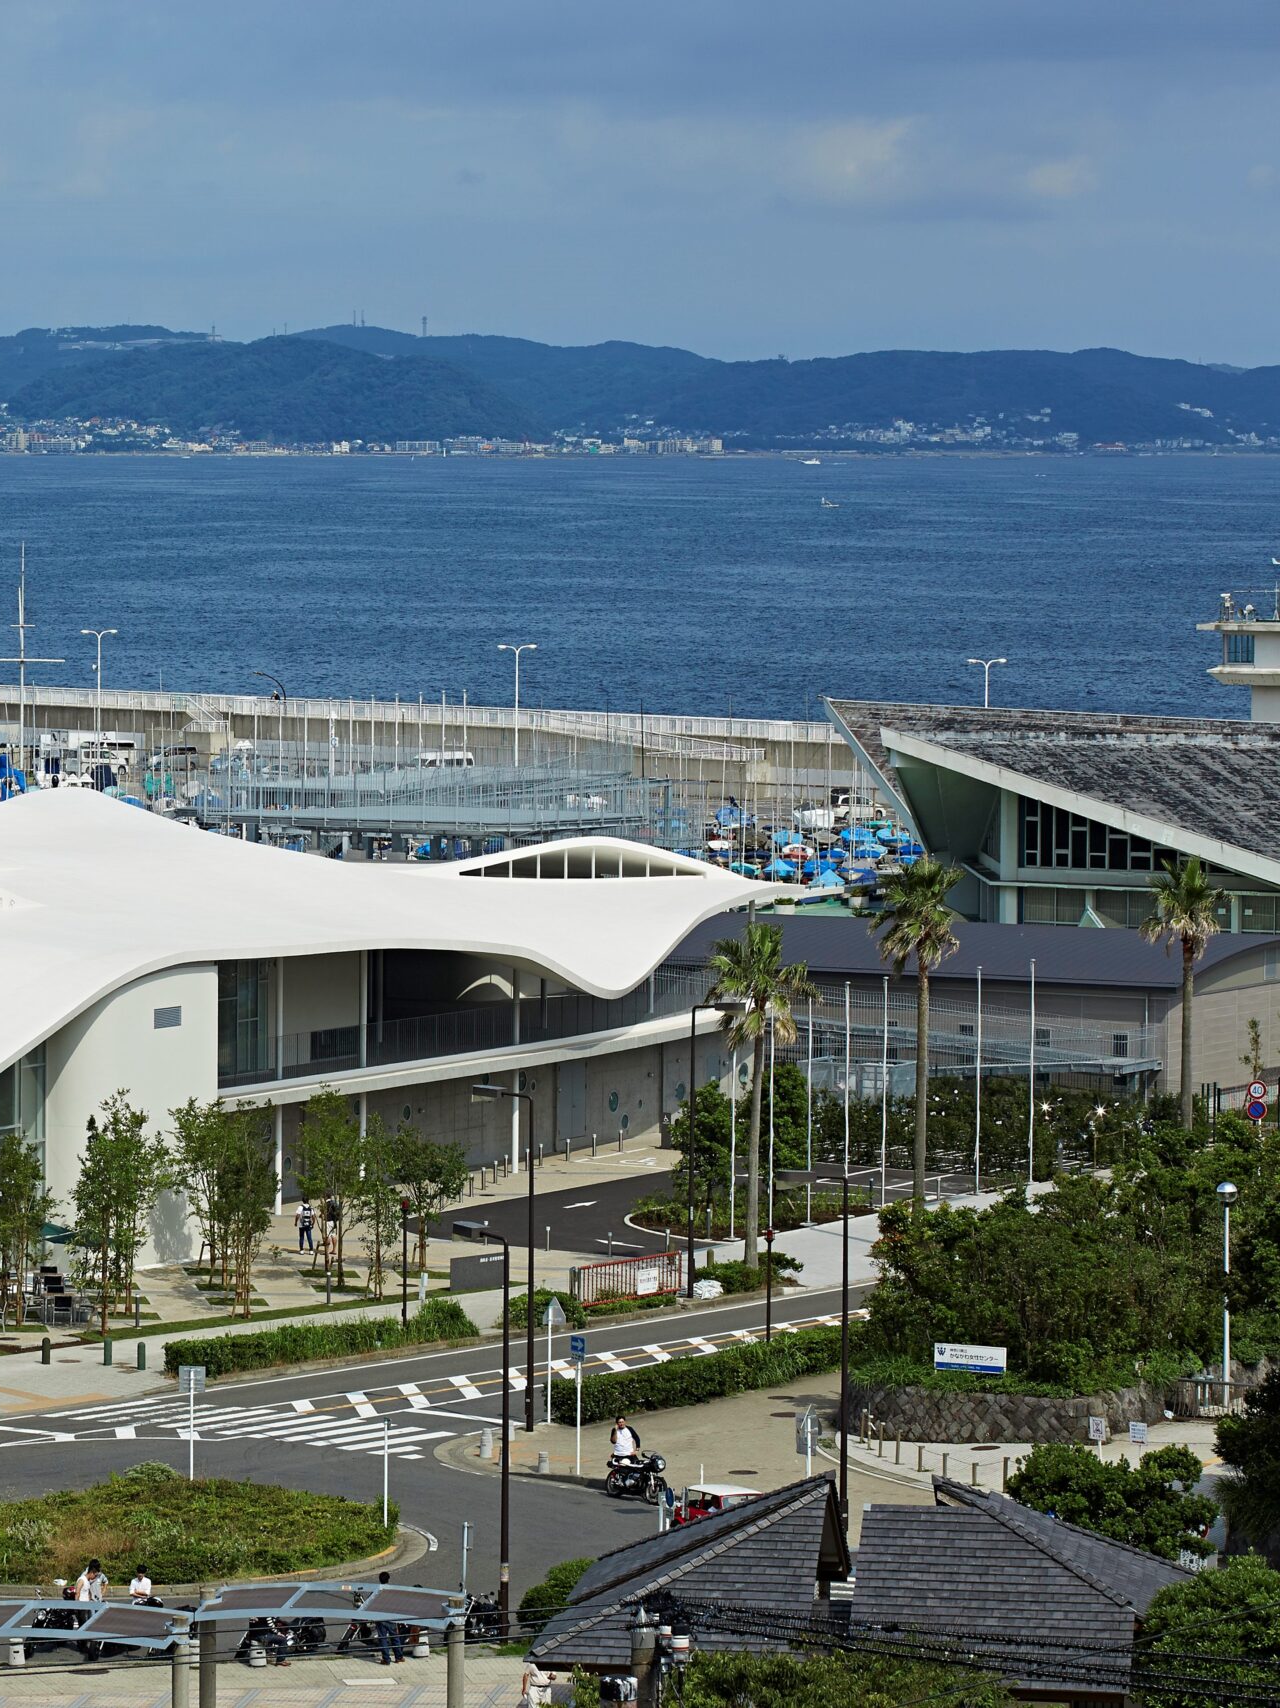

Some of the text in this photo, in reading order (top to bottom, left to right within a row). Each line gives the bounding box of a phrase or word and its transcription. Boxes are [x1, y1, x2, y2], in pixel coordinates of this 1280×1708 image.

[1252, 1086, 1262, 1094] 40
[950, 1353, 999, 1362] かながわ女性センター
